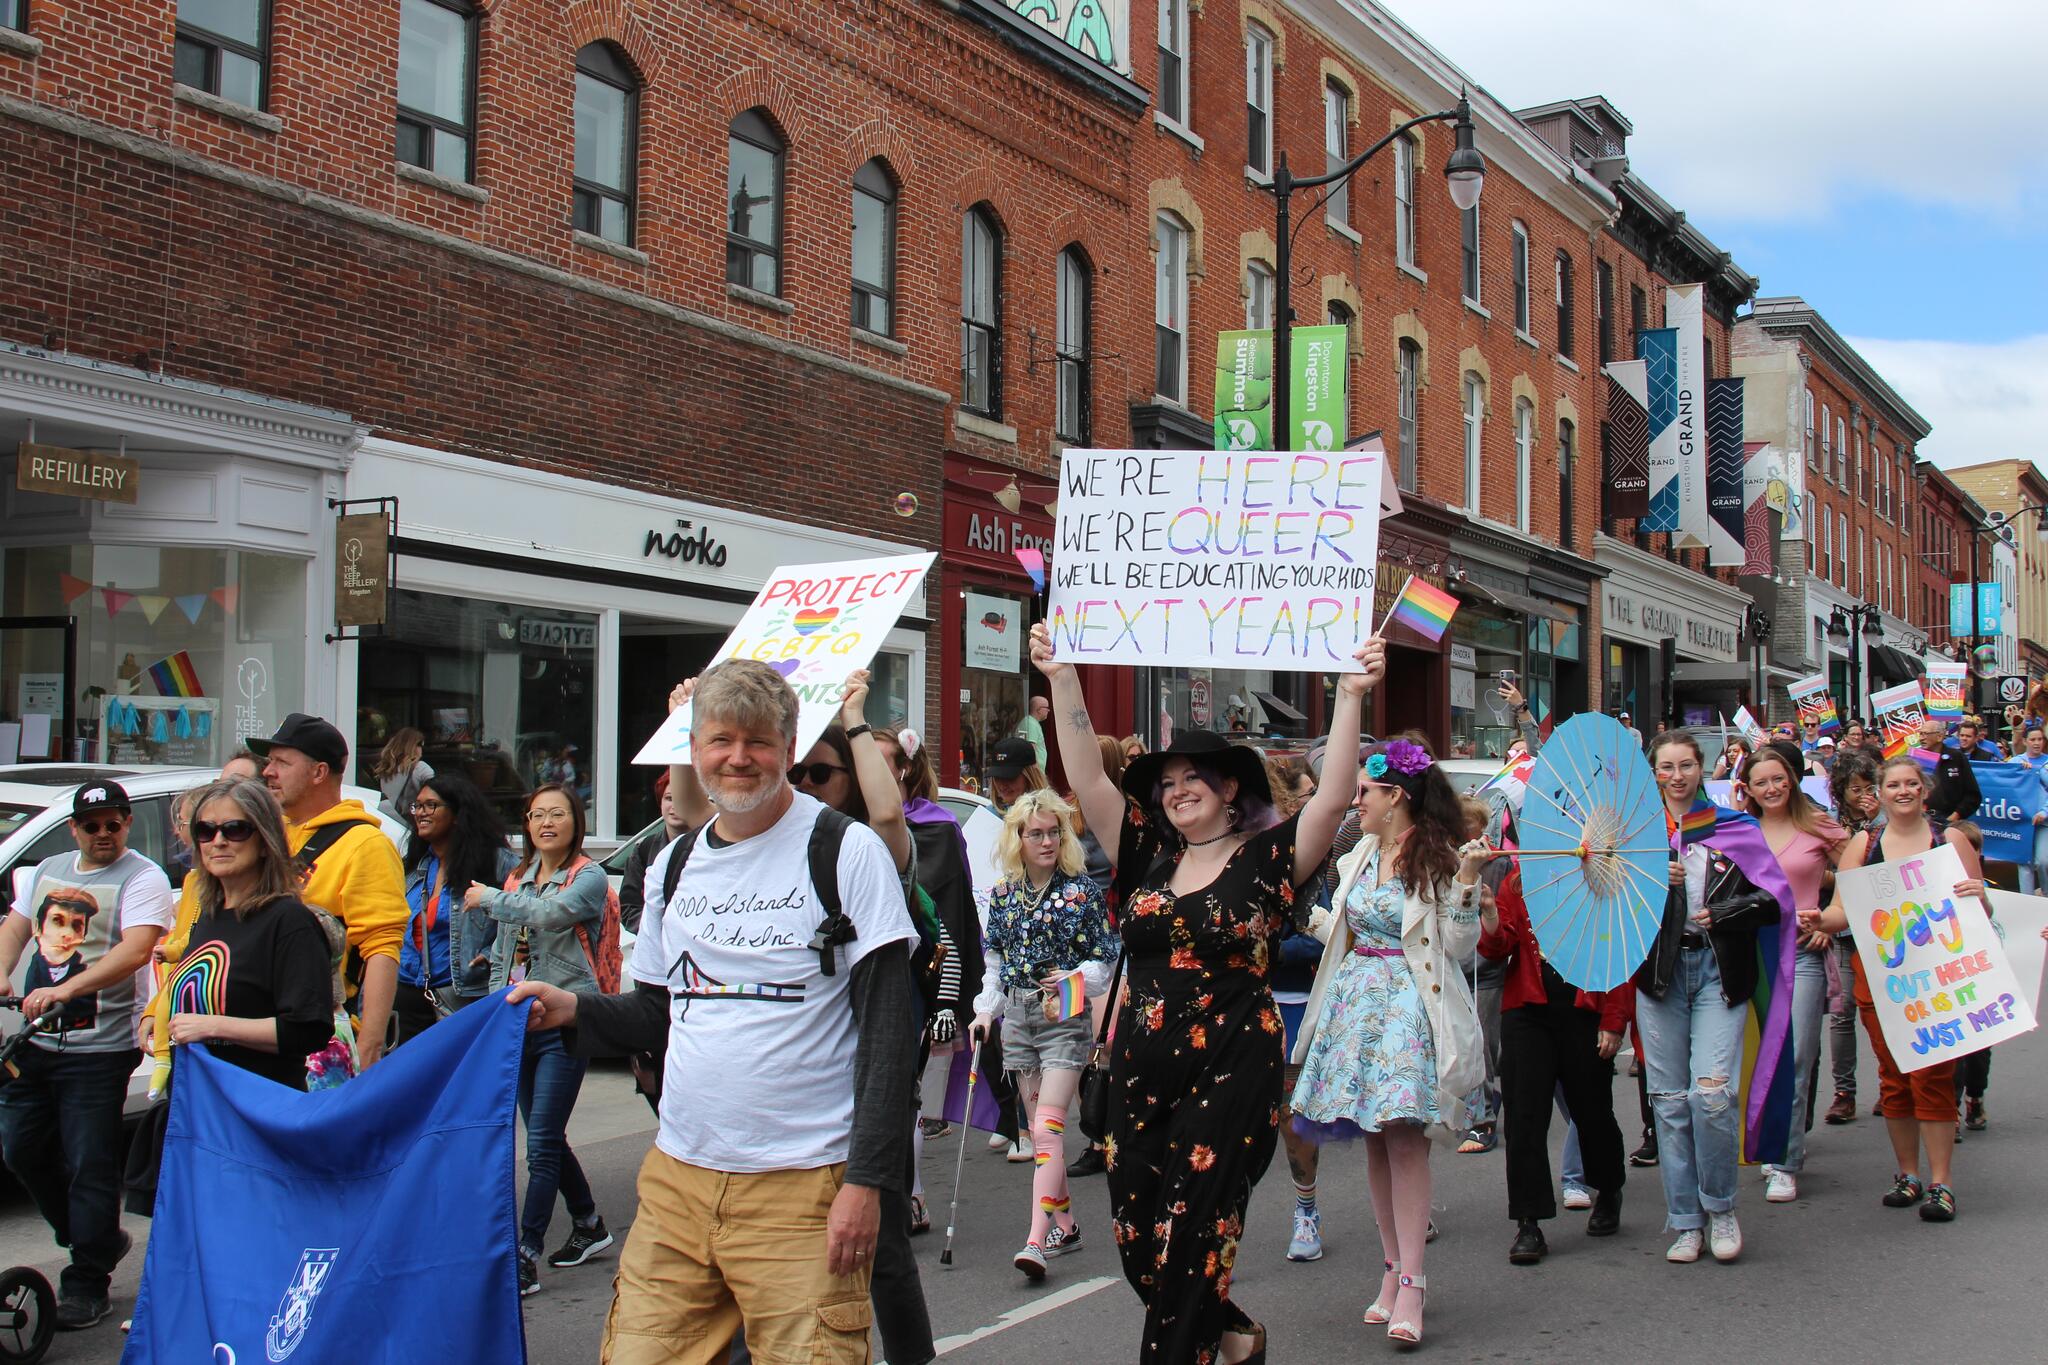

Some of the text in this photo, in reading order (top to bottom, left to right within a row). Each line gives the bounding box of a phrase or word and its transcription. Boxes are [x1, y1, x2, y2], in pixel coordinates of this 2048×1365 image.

[1233, 338, 1248, 411] summer
[1248, 337, 1258, 381] Celebrate
[1305, 342, 1321, 412] Kingston
[1321, 341, 1333, 399] Downtown
[1679, 389, 1693, 456] GRAND
[31, 457, 127, 489] REFILLERY
[1065, 455, 1377, 509] WE'RE HERE
[1614, 480, 1647, 489] GRAND
[1744, 478, 1765, 486] RAND
[1711, 498, 1742, 507] GRAND
[677, 519, 692, 529] THE
[967, 513, 1053, 563] Ash Fore
[1062, 506, 1354, 562] WE'RE QUEER
[644, 526, 727, 567] nooks
[344, 578, 378, 587] REFILLERY
[760, 568, 922, 607] PROTECT
[1057, 563, 1116, 588] WE'LL
[1125, 562, 1159, 588] BE
[1160, 562, 1289, 590] EDUCATING
[1337, 566, 1375, 590] KIDS
[730, 632, 864, 662] LGBTQ
[1050, 596, 1360, 661] NEXT YEAR!
[1642, 605, 1682, 638] GRAND
[1687, 619, 1736, 655] THEATRE
[235, 705, 257, 718] THE
[236, 718, 263, 731] KEEP
[1976, 797, 2021, 821] ride
[1869, 860, 1926, 899] IS IT
[711, 887, 806, 915] Islands
[749, 926, 802, 947] Inc.
[1870, 898, 1964, 969] gay
[1886, 950, 1993, 1003] OUT HERE
[1904, 981, 1976, 1023] OR IS IT
[1910, 993, 2016, 1055] JUST ME?
